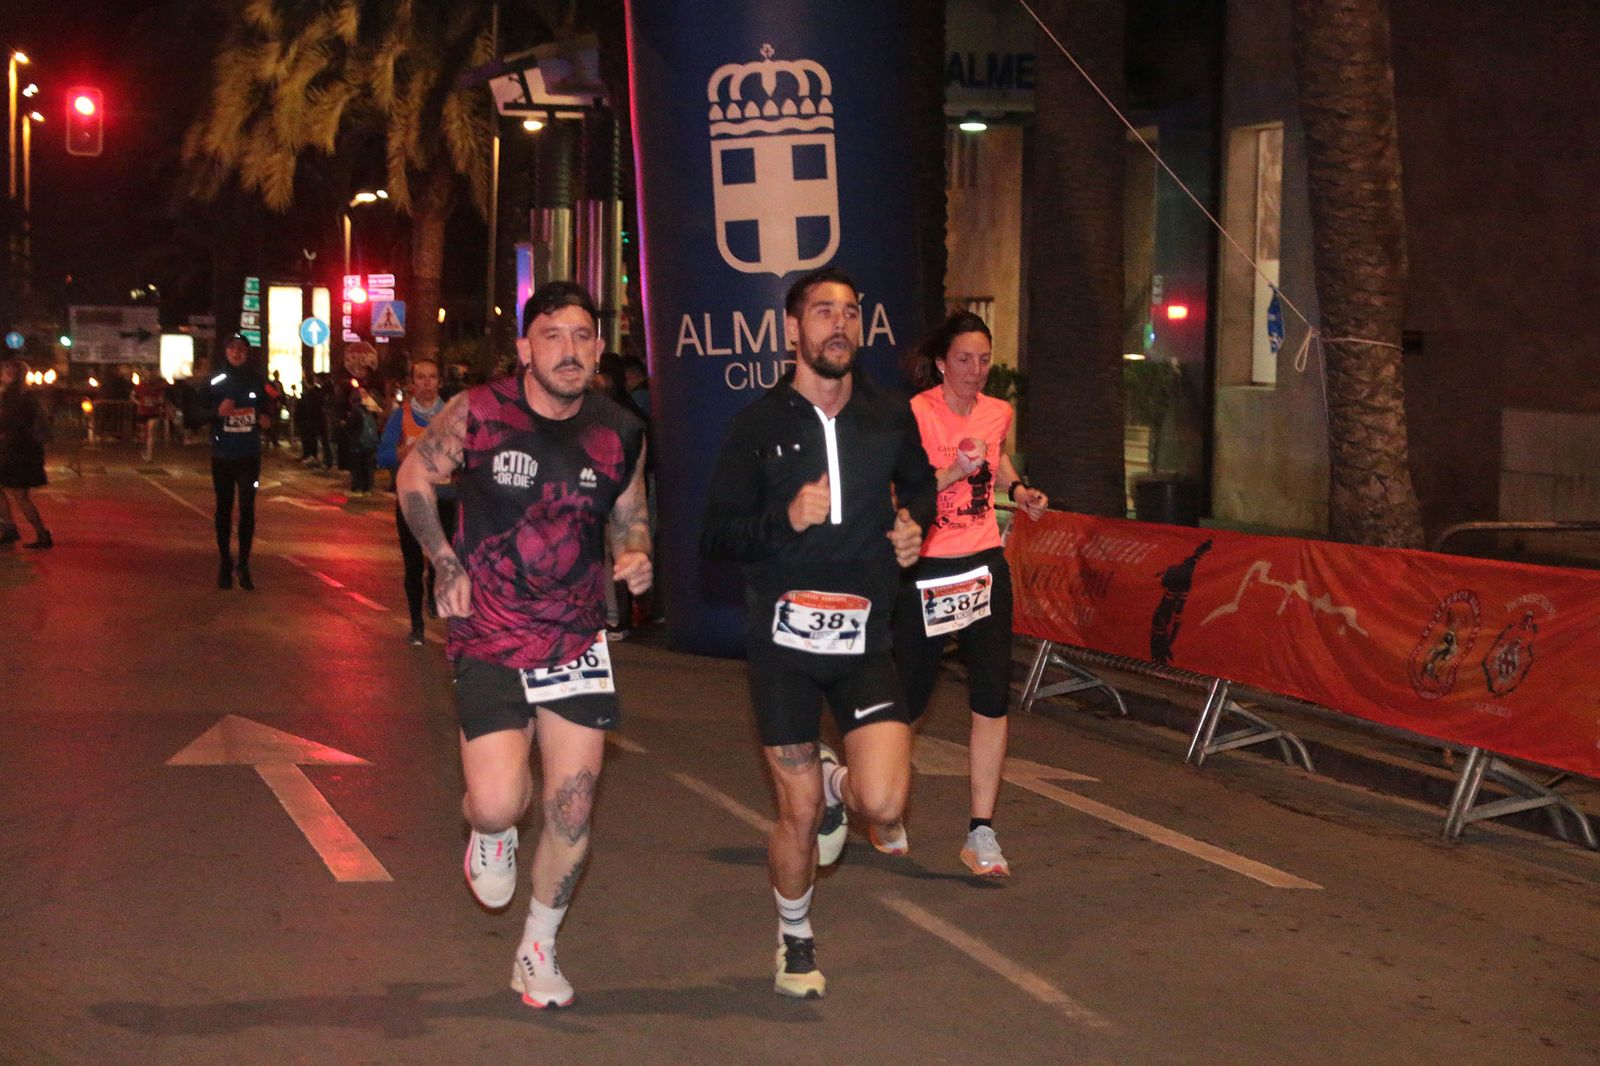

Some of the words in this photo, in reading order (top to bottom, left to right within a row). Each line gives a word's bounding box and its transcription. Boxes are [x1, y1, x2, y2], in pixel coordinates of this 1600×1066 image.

[676, 293, 896, 358] ALMÍA
[513, 473, 531, 488] DIE
[942, 589, 984, 615] 387
[809, 611, 845, 631] 38
